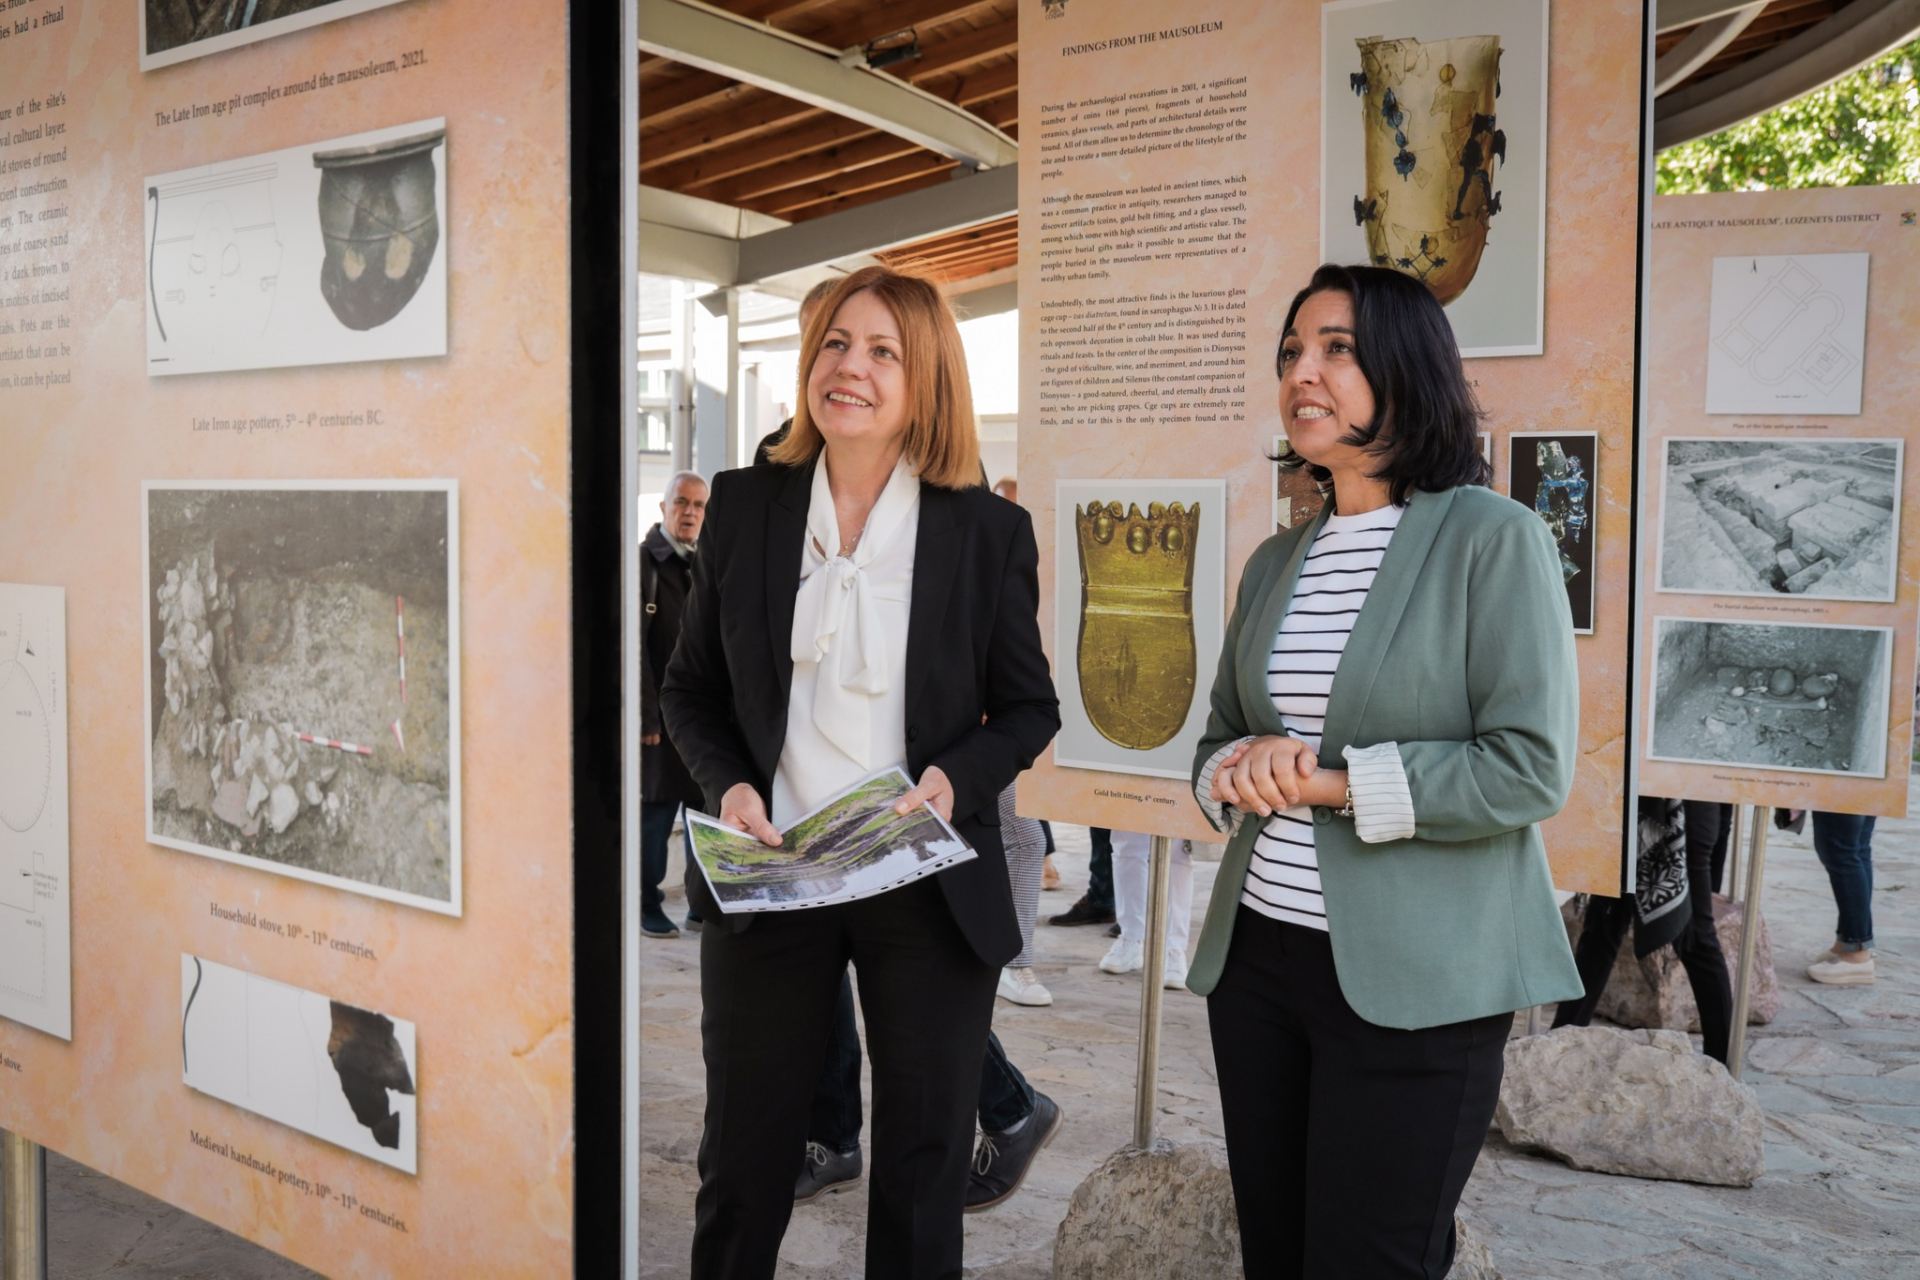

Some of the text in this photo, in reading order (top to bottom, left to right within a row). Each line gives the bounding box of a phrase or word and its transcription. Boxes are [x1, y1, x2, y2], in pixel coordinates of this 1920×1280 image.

[15, 5, 63, 35] had a ritual
[1062, 21, 1223, 56] FINDINGS FROM THE MAUSOLEUM
[155, 51, 428, 126] The Late Iron age pit complex around the mausoleum, 2021.
[1041, 104, 1065, 113] During
[1066, 101, 1078, 109] the
[1080, 93, 1127, 107] archaeological
[1129, 89, 1168, 99] excavations
[1181, 83, 1199, 92] 2001,
[1208, 76, 1247, 89] significant
[16, 101, 24, 116] of
[29, 98, 41, 113] the
[1041, 105, 1247, 139] ceramics, glass vessels, and parts of architectural details were
[13, 123, 67, 144] cultural layer.
[1041, 143, 1062, 152] found.
[1063, 141, 1074, 149] All
[1100, 136, 1119, 144] allow
[1137, 129, 1172, 139] determine
[1173, 127, 1184, 135] the
[1185, 123, 1225, 133] chronology
[1226, 119, 1234, 128] of
[1235, 118, 1247, 126] the
[8, 146, 67, 172] stoves of round
[20, 176, 68, 197] construction
[1041, 194, 1072, 204] Although
[1073, 193, 1084, 201] the
[1085, 190, 1124, 199] mausoleum
[1140, 184, 1162, 193] looted
[1164, 183, 1172, 191] in
[1173, 181, 1199, 190] ancient
[1200, 179, 1222, 187] times,
[1224, 174, 1247, 184] which
[18, 203, 68, 224] The ceramic
[1673, 220, 1714, 229] ANTIQUE
[1785, 215, 1834, 225] LOZENETS
[1835, 213, 1881, 222] DISTRICT
[1064, 233, 1084, 241] which
[1103, 229, 1119, 237] with
[1120, 227, 1136, 237] high
[1137, 225, 1168, 234] scientific
[1169, 223, 1183, 231] and
[1183, 221, 1208, 230] artistic
[1209, 219, 1231, 227] value.
[1233, 217, 1247, 225] The
[13, 230, 68, 253] of coarse sand
[4, 261, 70, 280] a dark brown to
[6, 286, 70, 307] motifs of incised
[1041, 299, 1084, 308] Undoubtedly,
[1116, 295, 1148, 303] attractive
[1149, 293, 1168, 301] finds
[1178, 291, 1190, 299] the
[1192, 290, 1226, 298] luxurious
[1228, 288, 1246, 298] glass
[20, 314, 70, 332] Pots are the
[1054, 338, 1087, 348] openwork
[1089, 337, 1124, 345] decoration
[1135, 334, 1156, 342] cobalt
[1158, 333, 1175, 341] blue.
[1178, 332, 1184, 340] It
[1202, 330, 1219, 339] used
[1221, 330, 1246, 339] during
[26, 345, 41, 359] that
[44, 347, 57, 357] can
[61, 342, 70, 356] be
[13, 369, 71, 389] it can be placed
[192, 418, 211, 431] Late
[212, 417, 231, 430] Iron
[232, 419, 248, 433] age
[249, 416, 284, 432] pottery,
[319, 411, 364, 427] centuries
[366, 410, 385, 425] BC.
[1094, 789, 1109, 797] Gold
[1110, 790, 1122, 798] belt
[1123, 792, 1144, 802] fitting,
[1152, 797, 1178, 806] century.
[210, 903, 257, 927] Household
[259, 918, 285, 937] stove,
[330, 939, 378, 961] centuries.
[190, 1130, 229, 1157] Medieval
[230, 1147, 277, 1177] handmade
[278, 1170, 314, 1194] pottery,
[359, 1205, 409, 1233] centuries.
